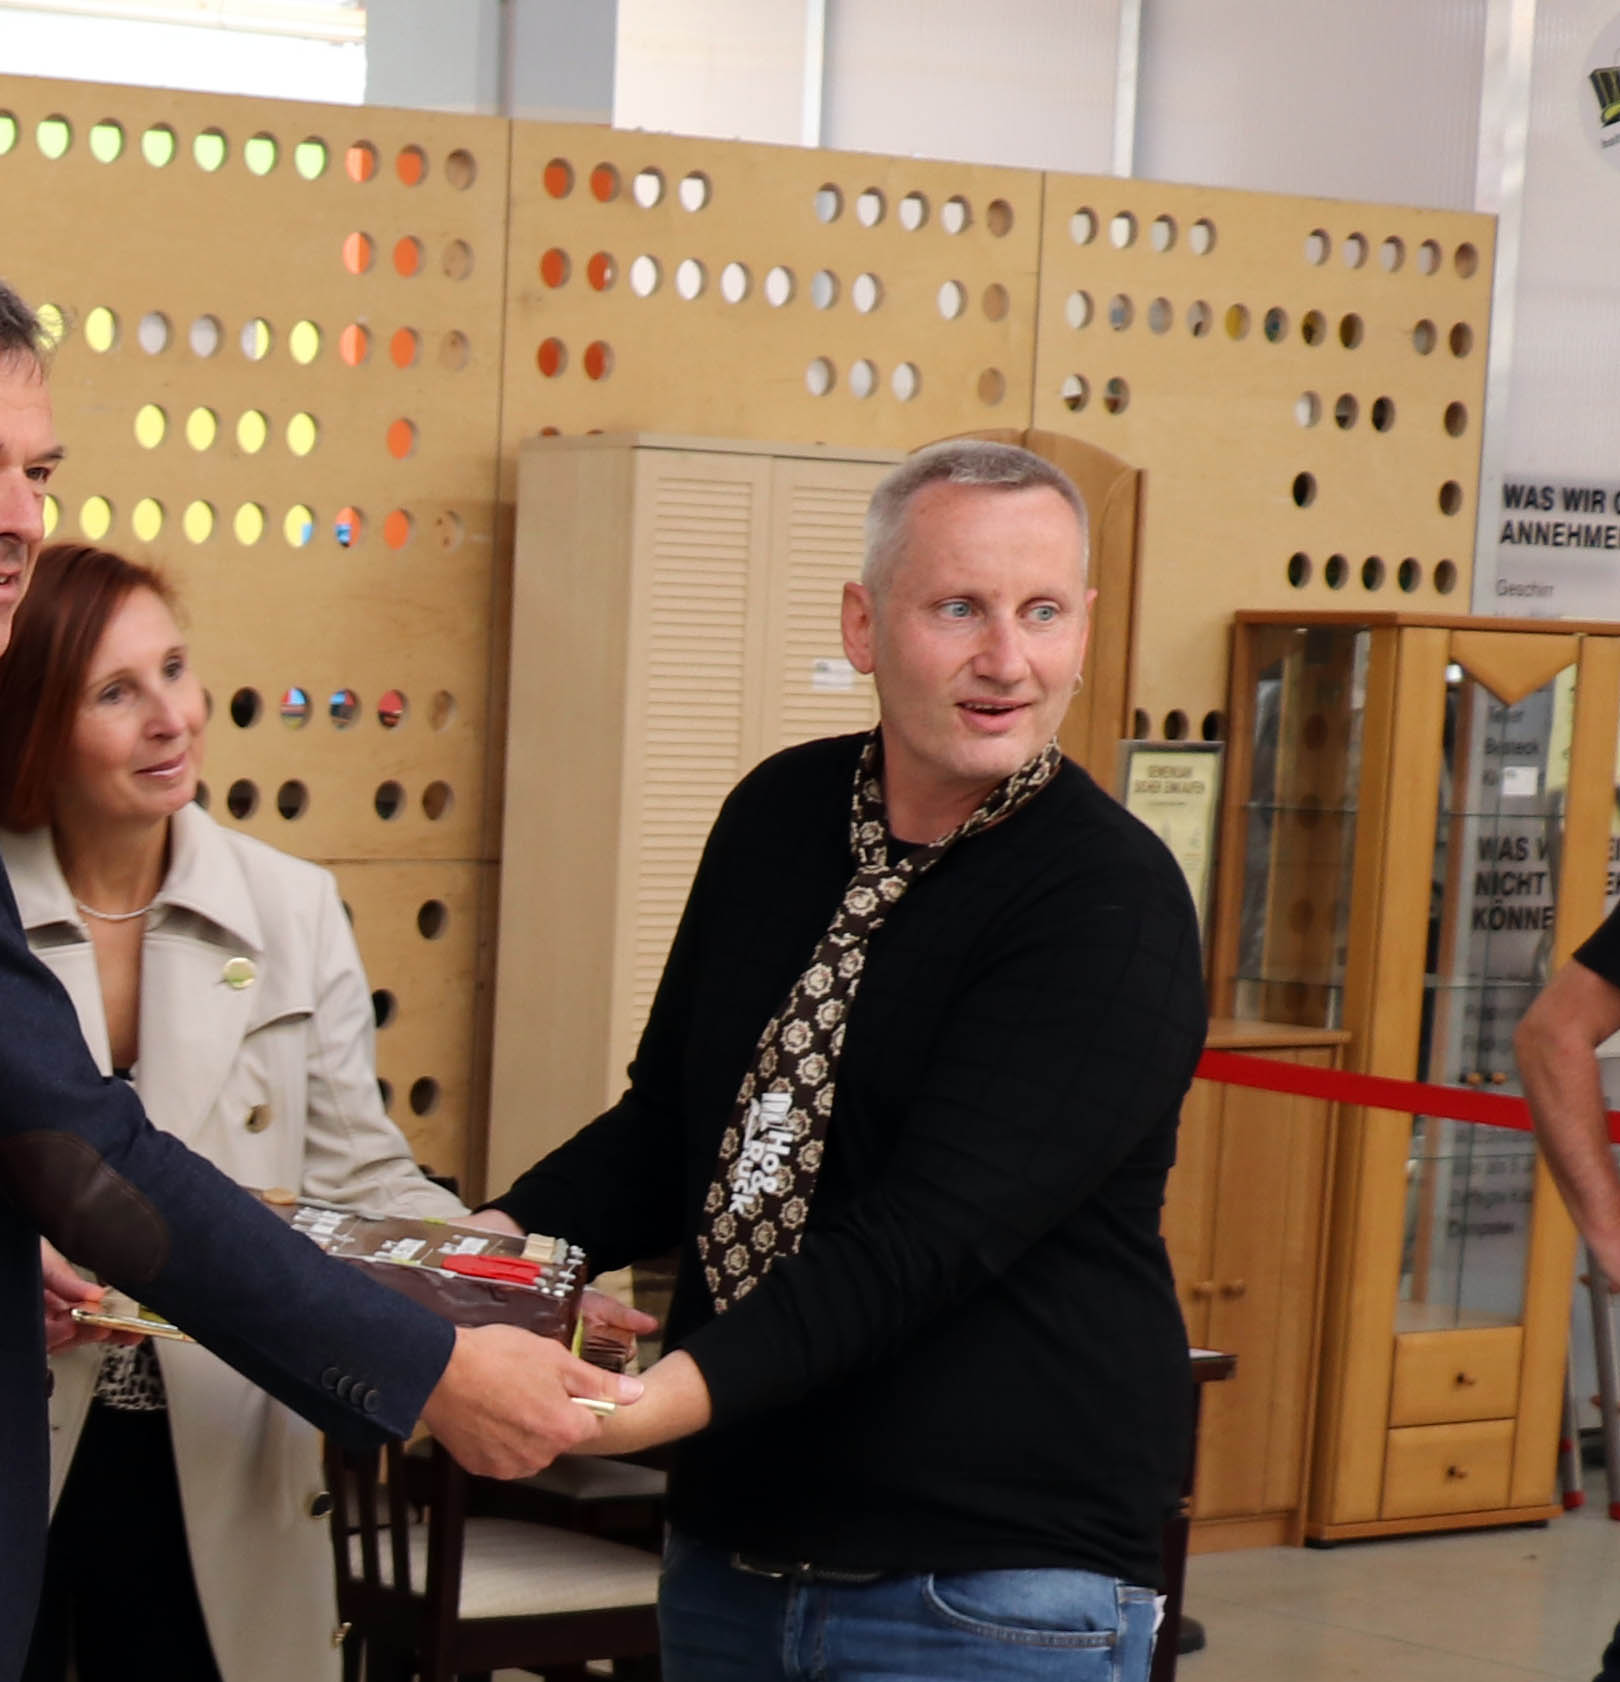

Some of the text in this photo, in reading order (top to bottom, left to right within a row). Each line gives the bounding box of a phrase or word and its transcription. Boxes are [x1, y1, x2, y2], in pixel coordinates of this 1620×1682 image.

[1502, 483, 1555, 512] WAS
[1561, 487, 1607, 514] WIR
[1499, 519, 1620, 550] ANNEHME
[1476, 836, 1530, 862] WAS
[1474, 870, 1547, 897] NICHT
